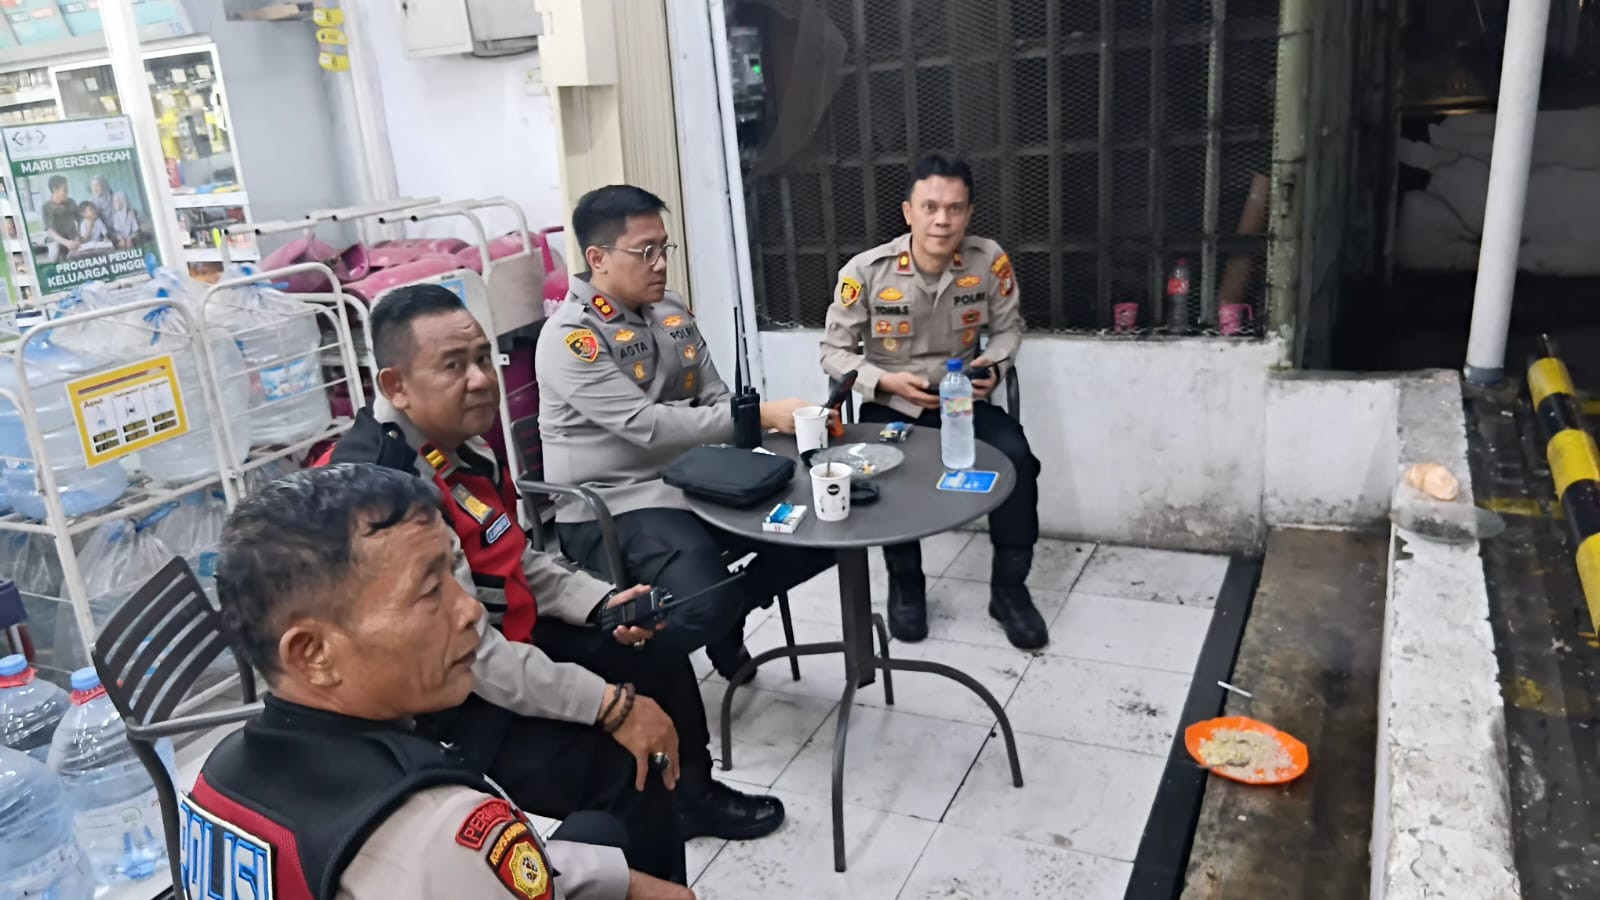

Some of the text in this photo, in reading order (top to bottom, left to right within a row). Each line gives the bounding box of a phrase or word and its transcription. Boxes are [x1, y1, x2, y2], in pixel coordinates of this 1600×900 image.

[21, 150, 130, 174] MARI BERSEDEKAH
[56, 248, 143, 273] PROGRAM PEDULI
[48, 267, 108, 287] KELUARGA
[954, 291, 986, 306] POLRI
[669, 325, 694, 341] POLRI
[620, 341, 649, 359] AGTA
